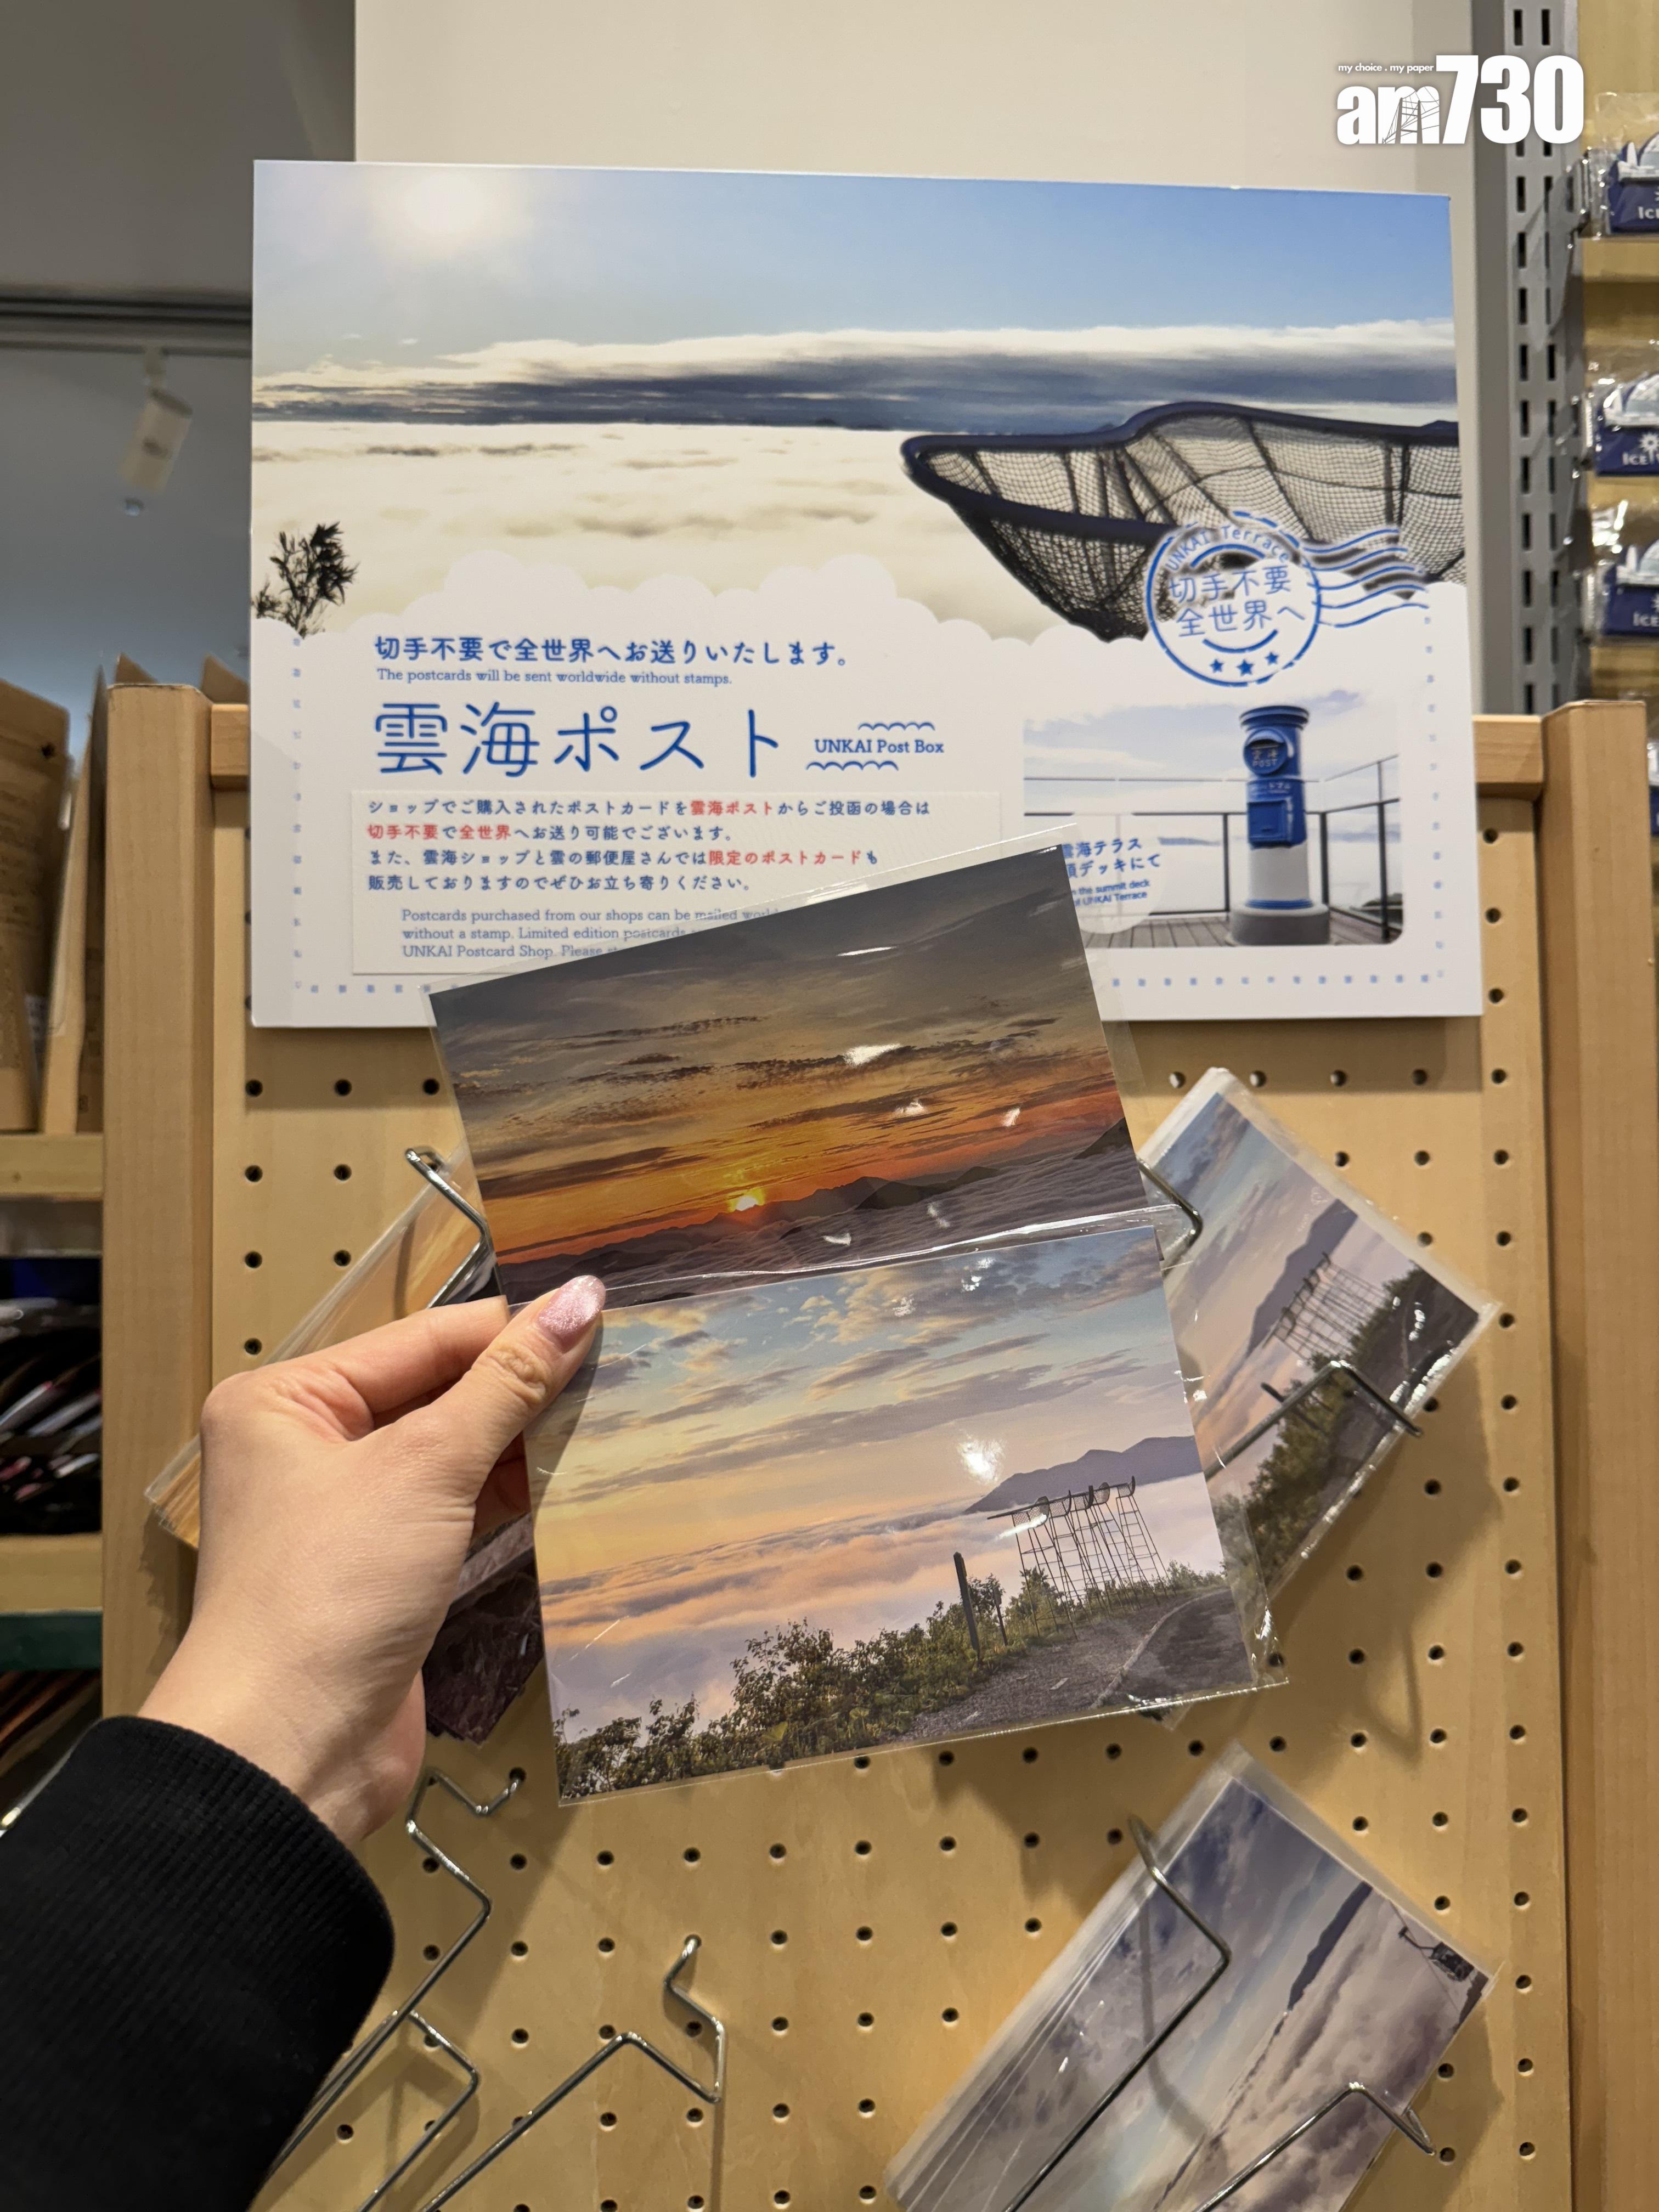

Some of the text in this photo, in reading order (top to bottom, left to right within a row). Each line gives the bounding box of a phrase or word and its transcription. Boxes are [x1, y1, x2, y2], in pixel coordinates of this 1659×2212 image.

[1165, 525, 1289, 572] UNKAI Terrace
[1169, 565, 1291, 603] 切手不要
[1176, 600, 1305, 637] 全世界へ
[374, 636, 845, 665] 切手不要で全世界へお送りいたします。
[377, 668, 732, 687] The postcards will be sent worldwide without stamps.
[374, 701, 778, 778] 雲海ポスト
[814, 738, 945, 753] UNKAI Post Box
[369, 799, 929, 816] ショップでご購入されたポストカードを雲海ポストからご投函の場合は
[367, 824, 730, 840] 切手不要で全世界へお送り可能でございます。
[369, 874, 748, 890] 販売しておりますのでぜひお立ち寄りください。
[1096, 882, 1126, 894] summit
[1129, 879, 1150, 889] deck
[1114, 891, 1147, 901] Terrace
[402, 909, 467, 921] Postcards
[472, 910, 540, 923] purchased
[545, 910, 575, 921] from
[580, 912, 601, 921] our
[606, 910, 642, 923] shops
[675, 909, 691, 920] be
[695, 909, 737, 921] mailed
[403, 928, 453, 939] without
[459, 931, 466, 939] a
[471, 929, 515, 942] stamp.
[520, 928, 568, 938] Limited
[574, 928, 618, 938] edition
[403, 945, 452, 957] UNKAI
[458, 946, 514, 956] Postcard
[562, 945, 603, 956] Please
